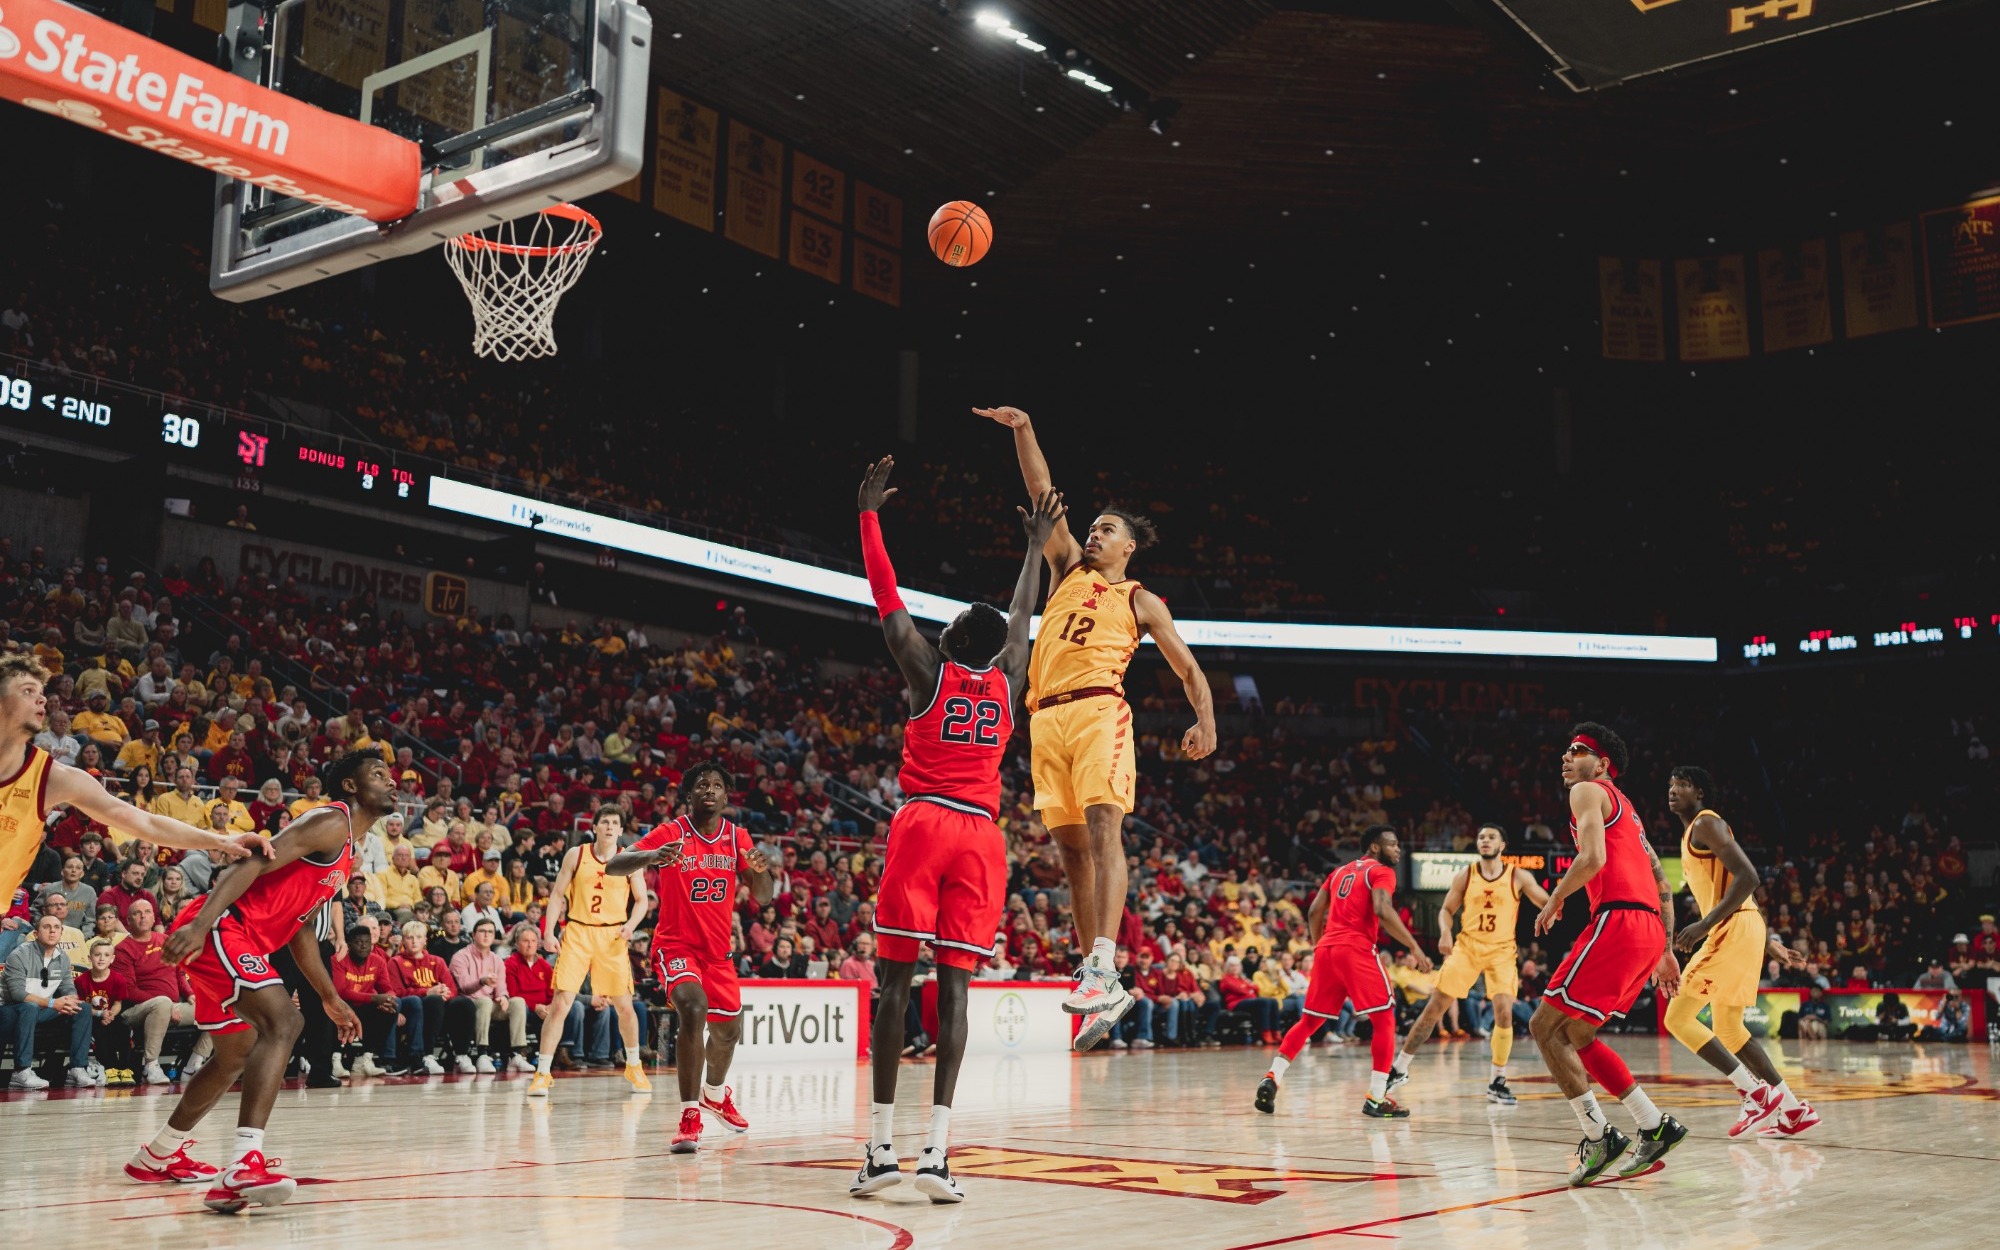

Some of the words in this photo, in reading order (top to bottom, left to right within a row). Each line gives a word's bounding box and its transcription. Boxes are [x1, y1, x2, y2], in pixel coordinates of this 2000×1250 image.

[803, 169, 834, 200] 42
[801, 226, 832, 258] 53
[864, 252, 892, 284] 32
[1610, 305, 1654, 319] NCAA
[1688, 303, 1737, 319] NCAA
[61, 396, 111, 426] 2ND
[162, 413, 200, 448] 30
[299, 447, 345, 469] BONUS
[357, 460, 379, 477] FLS
[237, 477, 260, 492] 133
[361, 474, 373, 490] 3
[391, 468, 415, 486] TOL
[398, 482, 409, 498] 2
[529, 508, 592, 533] Ntionwide
[239, 543, 422, 605] CYCLONES
[1058, 612, 1096, 647] 12
[941, 696, 1002, 747] 22
[690, 877, 728, 904] 23
[1337, 872, 1356, 899] 0
[590, 894, 603, 914] 2
[1478, 913, 1497, 933] 13
[739, 1004, 844, 1045] TriVolt
[1839, 1005, 1863, 1019] Two
